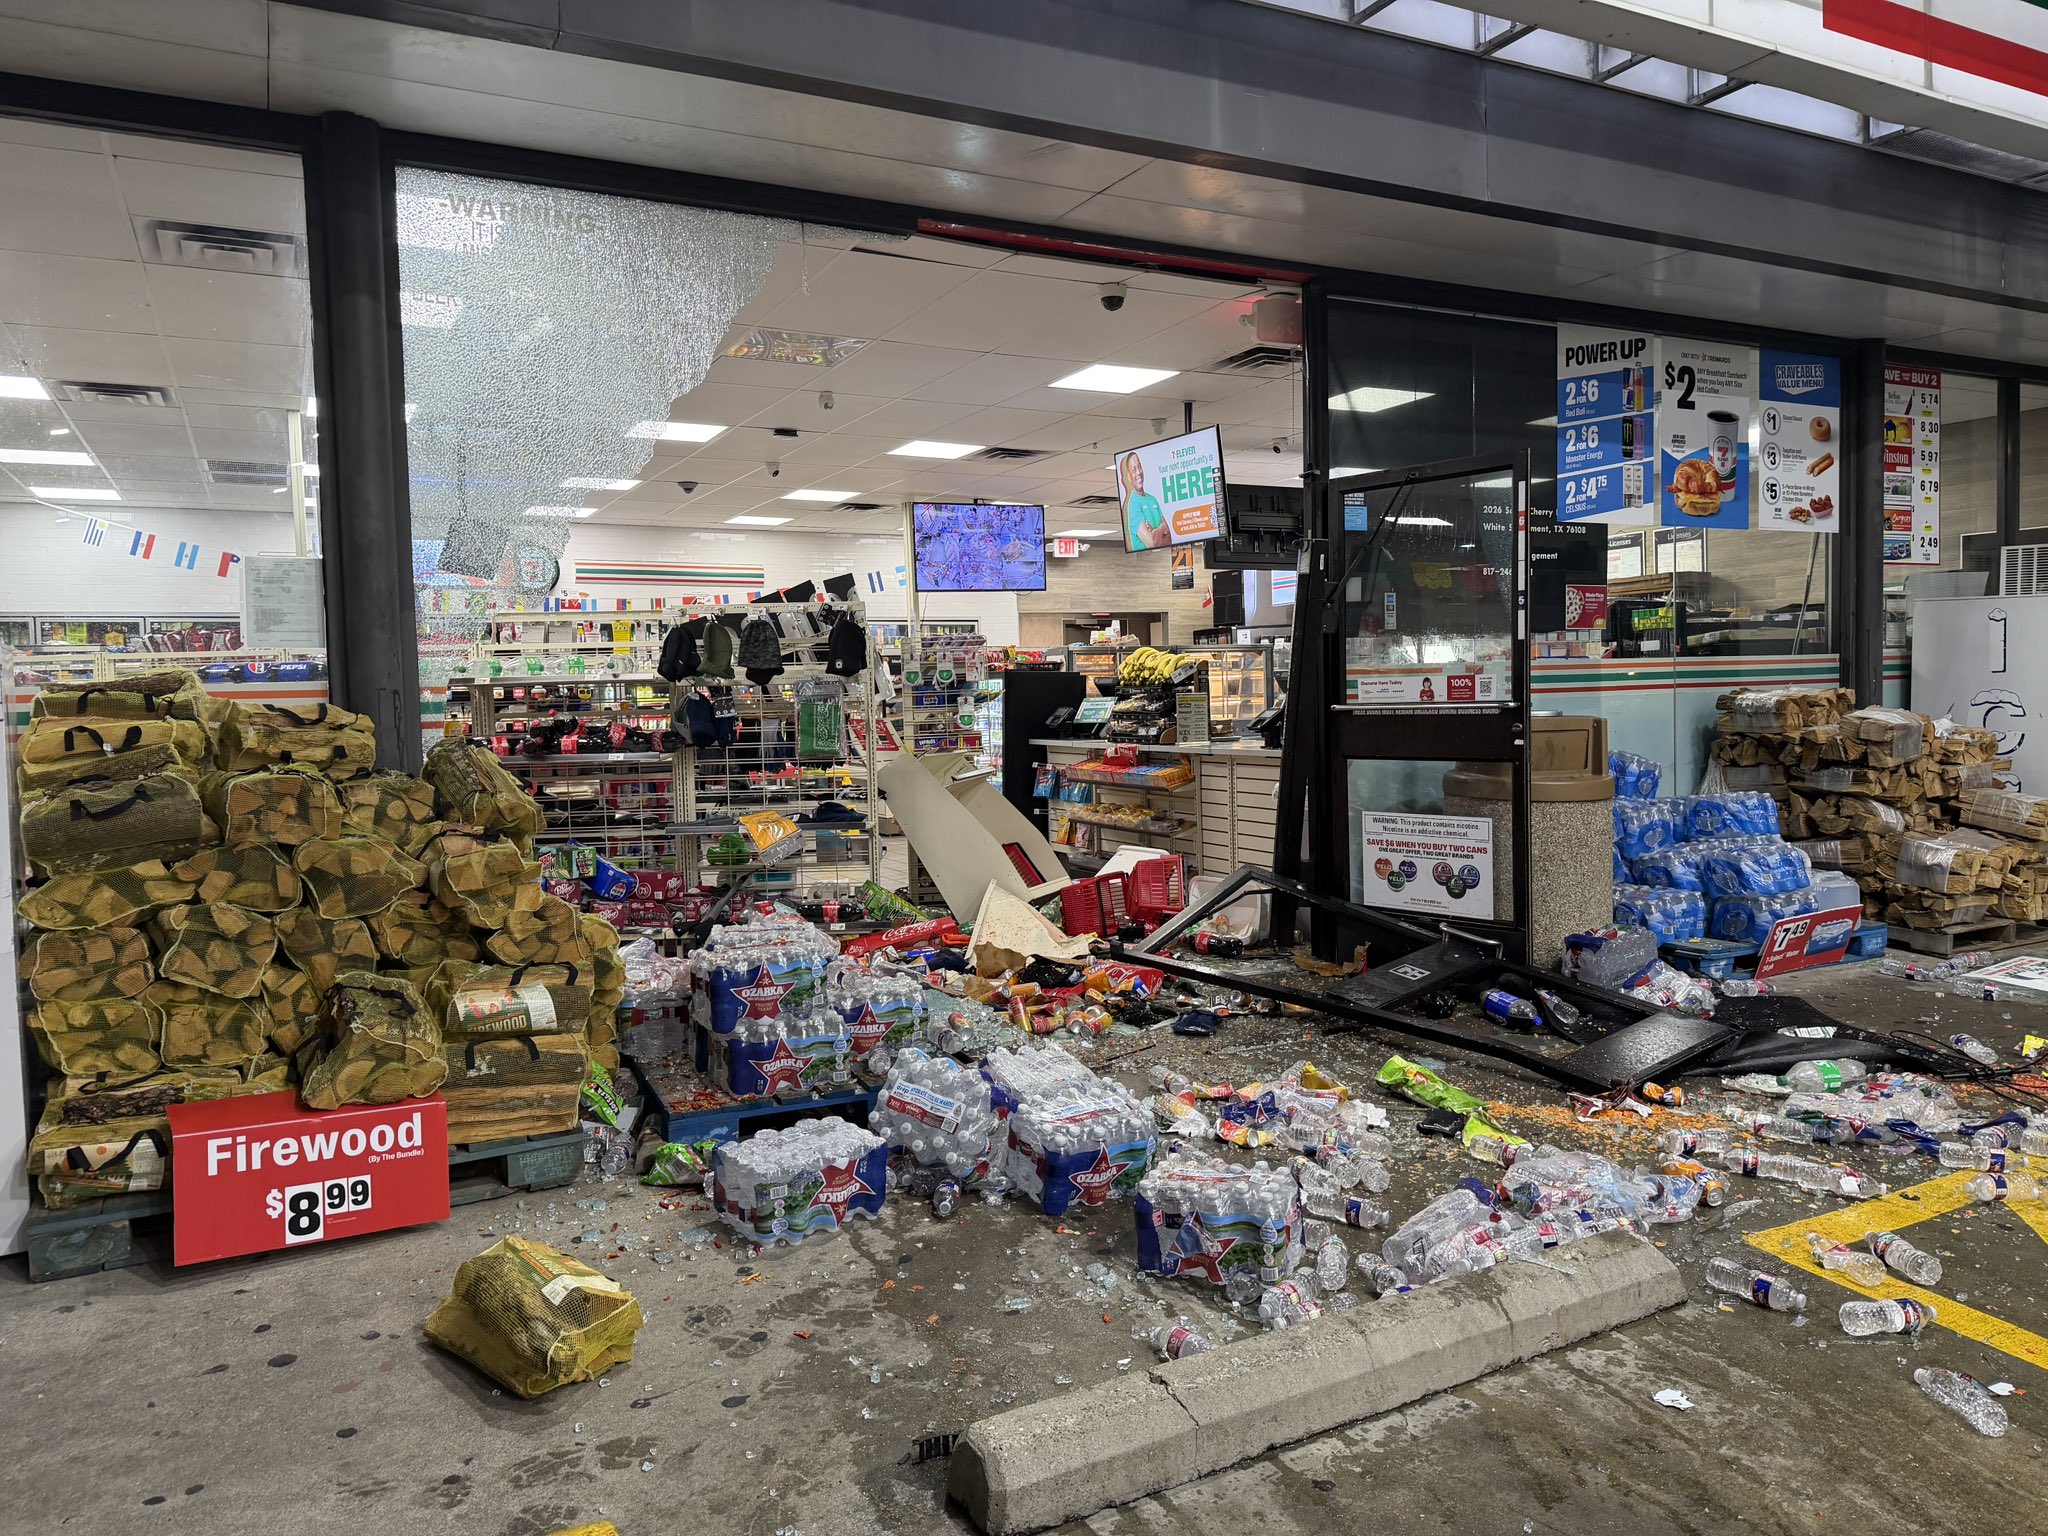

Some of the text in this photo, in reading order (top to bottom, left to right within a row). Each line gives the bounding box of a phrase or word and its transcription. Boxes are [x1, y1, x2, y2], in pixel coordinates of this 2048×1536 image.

[1565, 338, 1646, 367] POWER UP
[1706, 368, 1727, 378] Breakfast
[1727, 371, 1747, 379] Sandwich
[1776, 365, 1824, 379] CRAVEABLES
[1664, 361, 1696, 410] $2
[1709, 378, 1717, 386] you
[1717, 379, 1725, 387] buy
[1776, 379, 1824, 388] VALUE MENU
[1911, 373, 1930, 384] BUY
[1931, 375, 1938, 385] 2
[1565, 379, 1599, 406] 2 FOR $6
[1705, 386, 1720, 394] Coffee
[1565, 409, 1576, 417] Red
[1576, 407, 1586, 415] Bull
[1766, 412, 1777, 430] $1
[1565, 426, 1599, 452] 2 FOR $6
[1157, 453, 1214, 474] Your next opportunity is
[1565, 451, 1604, 464] Monster Energy
[1766, 451, 1777, 466] $3
[1161, 465, 1215, 504] HERE
[1766, 482, 1777, 499] $5
[1565, 481, 1576, 504] 2
[1576, 494, 1587, 502] FOR
[1482, 505, 1502, 514] 2026
[1565, 503, 1587, 513] CELSIUS
[1518, 516, 1525, 525] 6
[1483, 522, 1586, 534] White TX 76108
[1667, 531, 1692, 540] Licenses
[1058, 540, 1075, 554] EXIT
[1610, 539, 1632, 547] Licenses
[1172, 548, 1194, 571] 21
[1518, 595, 1525, 605] 5
[1450, 678, 1473, 687] 100%
[1372, 817, 1399, 825] WARNING:
[1412, 820, 1432, 828] product
[1382, 825, 1404, 833] Nicotine
[1418, 828, 1442, 836] addictive
[1443, 829, 1469, 838] chemical.
[1366, 838, 1488, 854] SAVE $6 WHEN YOU BUY TWO CANS
[1405, 848, 1422, 856] OFFER,
[1766, 954, 1783, 963] 7-Select
[741, 987, 784, 997] OZARKA
[848, 1024, 886, 1034] OZARKA
[762, 1058, 804, 1072] OZARKA
[207, 1111, 422, 1177] Firewood
[368, 1148, 424, 1164] (By The Bundle)
[1076, 1166, 1118, 1183] OZARKA
